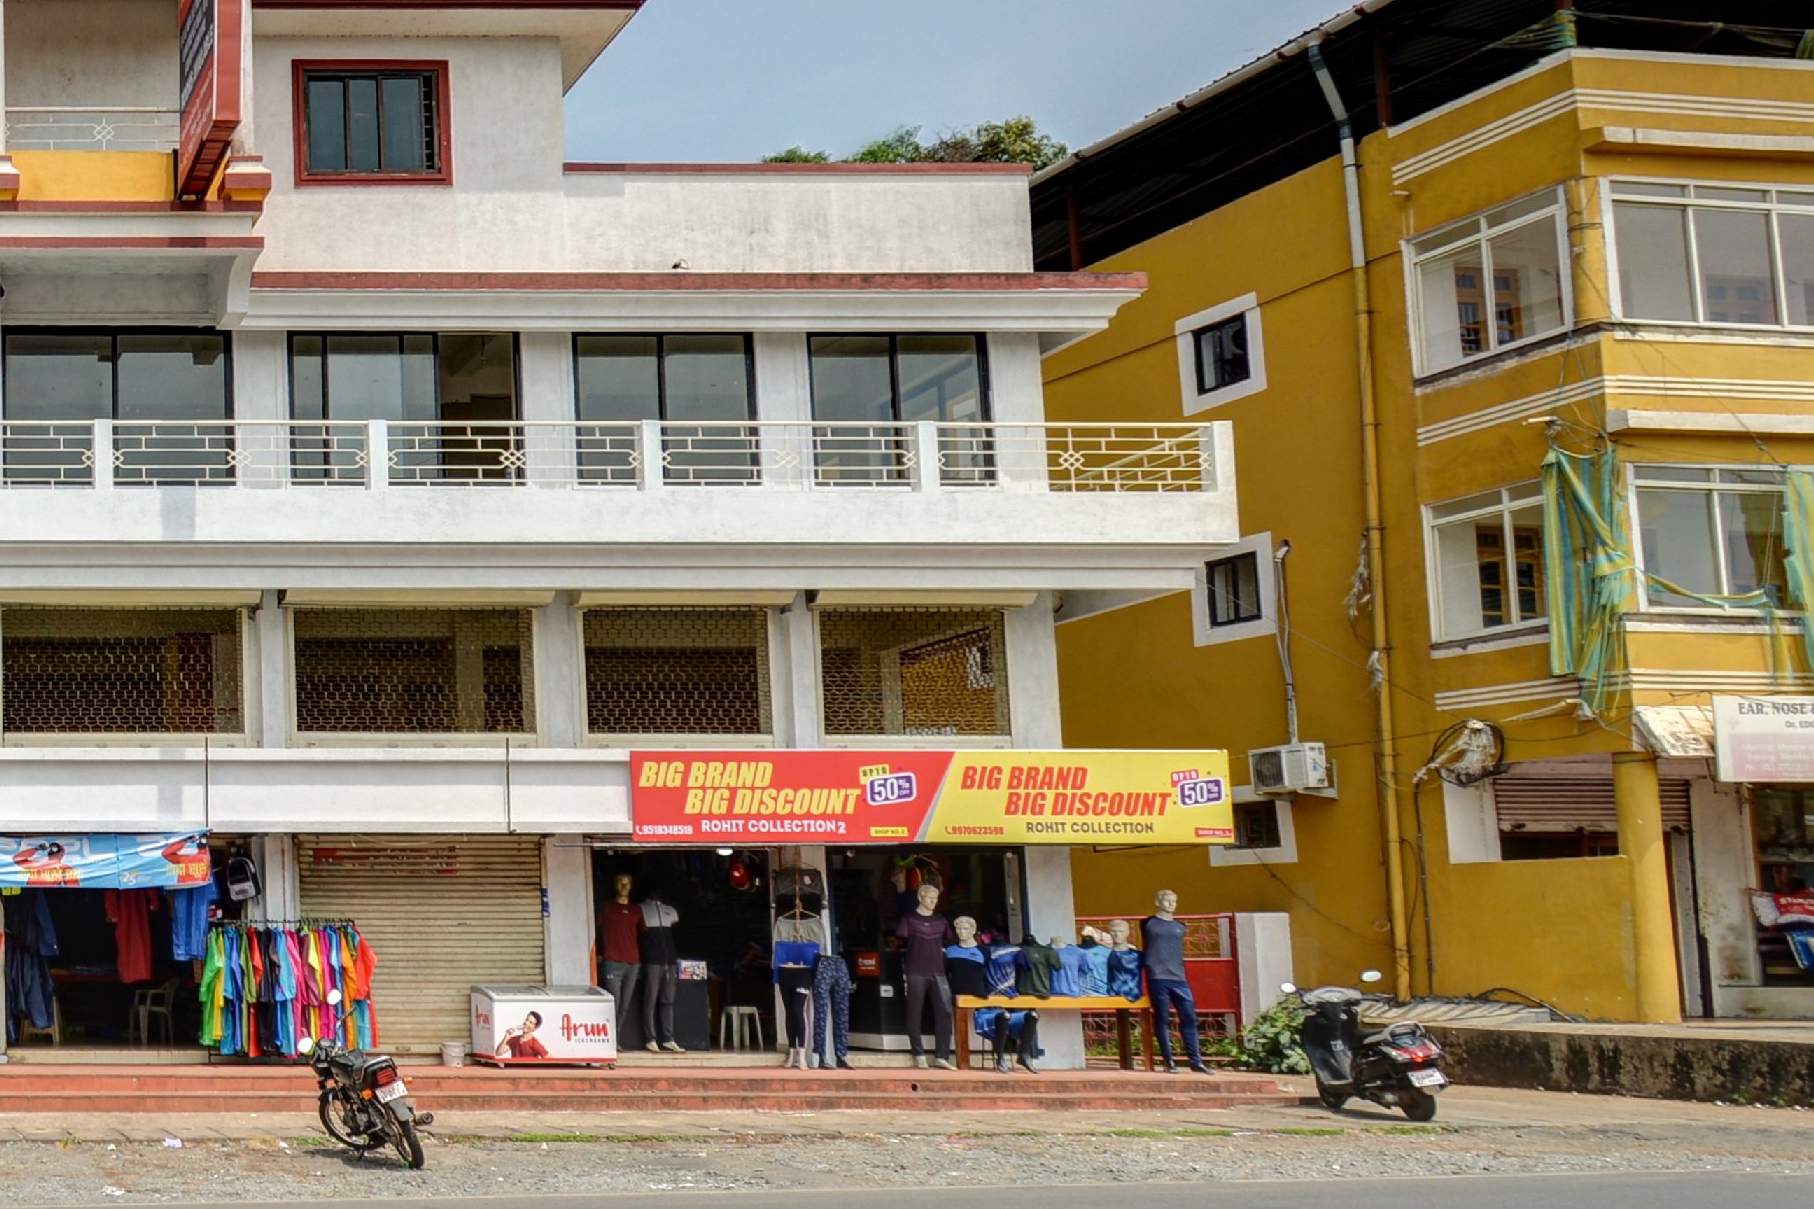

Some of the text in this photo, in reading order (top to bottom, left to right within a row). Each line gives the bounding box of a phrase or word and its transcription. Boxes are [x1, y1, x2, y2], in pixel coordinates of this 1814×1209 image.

[1772, 702, 1807, 715] NOSE
[639, 762, 773, 788] BIG BRAND
[960, 766, 1088, 791] BIG BRAND
[684, 789, 861, 815] BIG DISCOUNT
[1004, 792, 1172, 817] BIG DISCOUNT
[701, 820, 846, 834] ROHIT COLLECTION 2
[1026, 822, 1154, 834] ROHIT COLLECTION
[560, 1013, 609, 1041] Arun
